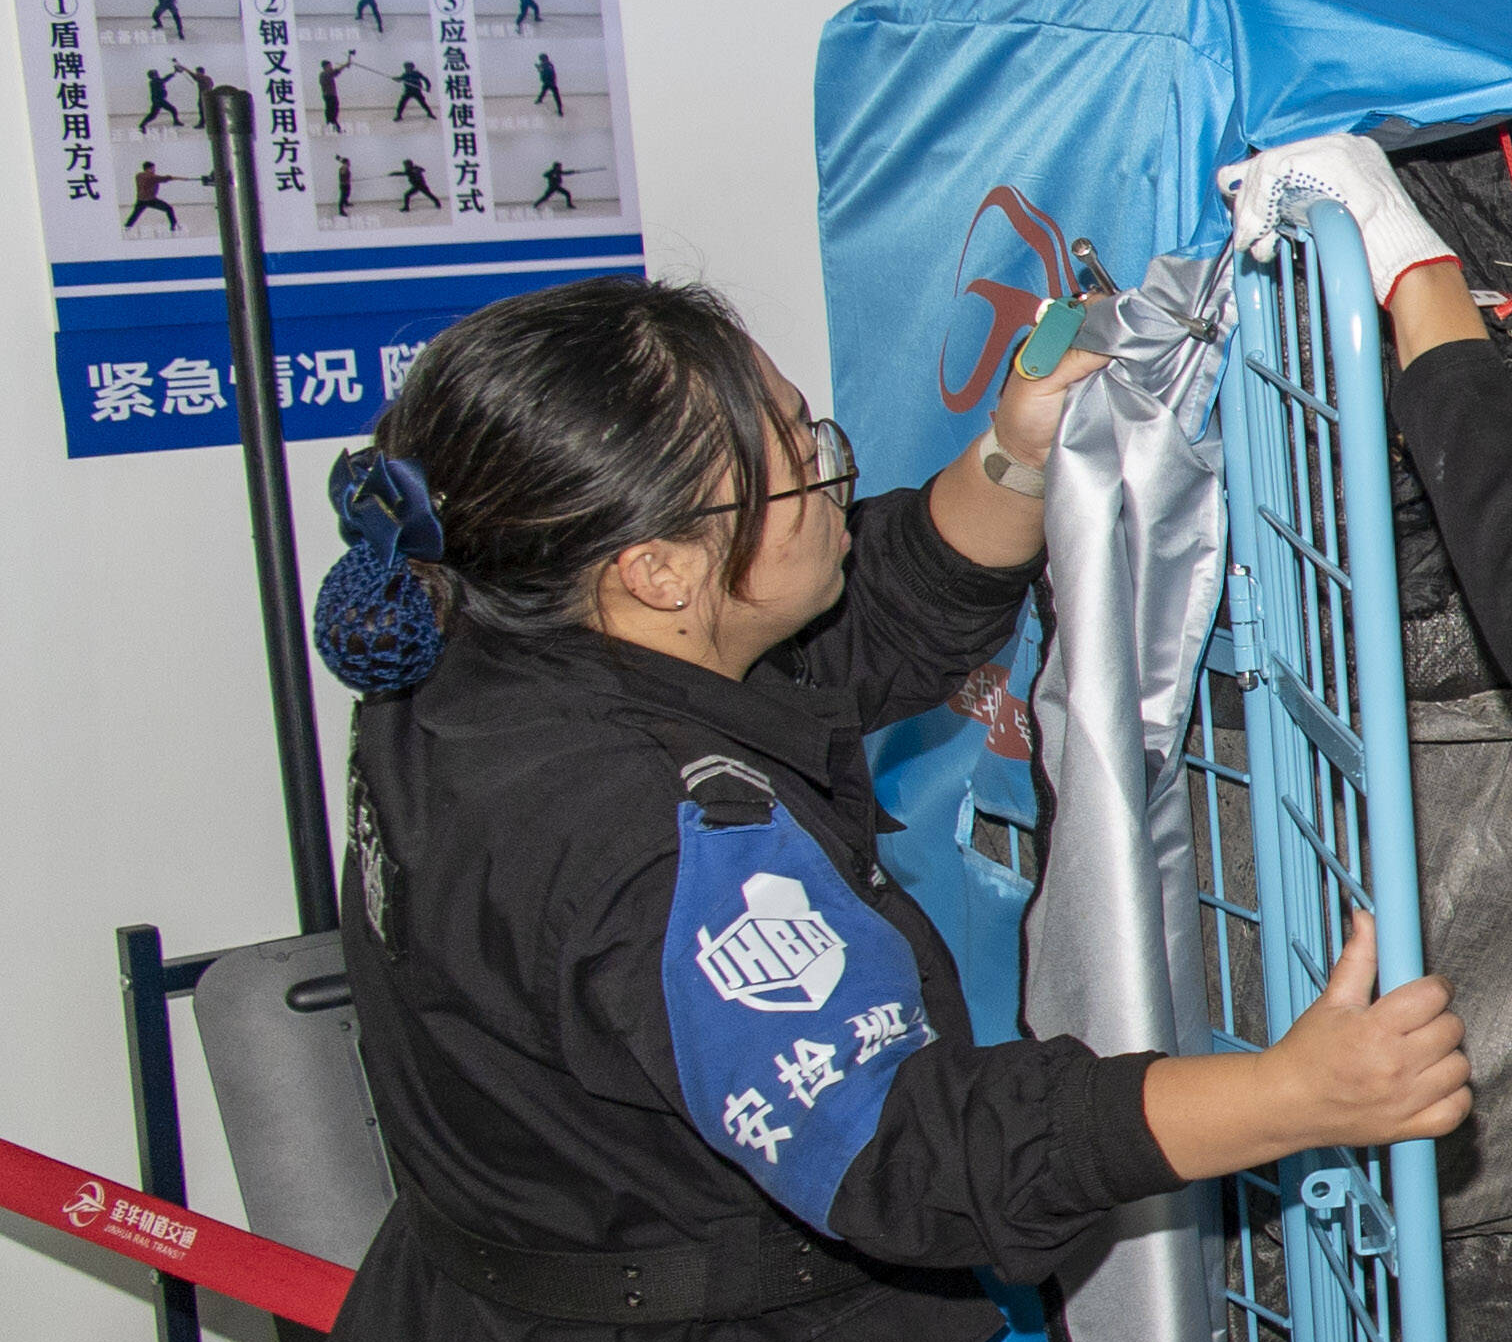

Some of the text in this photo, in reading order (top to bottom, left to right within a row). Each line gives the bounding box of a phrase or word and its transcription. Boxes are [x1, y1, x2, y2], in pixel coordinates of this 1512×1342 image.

[718, 918, 835, 991] JHBA
[722, 1001, 939, 1163] 安检班
[103, 1223, 187, 1261] JINHUA RAIL TRANSIT
[110, 1199, 198, 1250] 金华轨道交通
